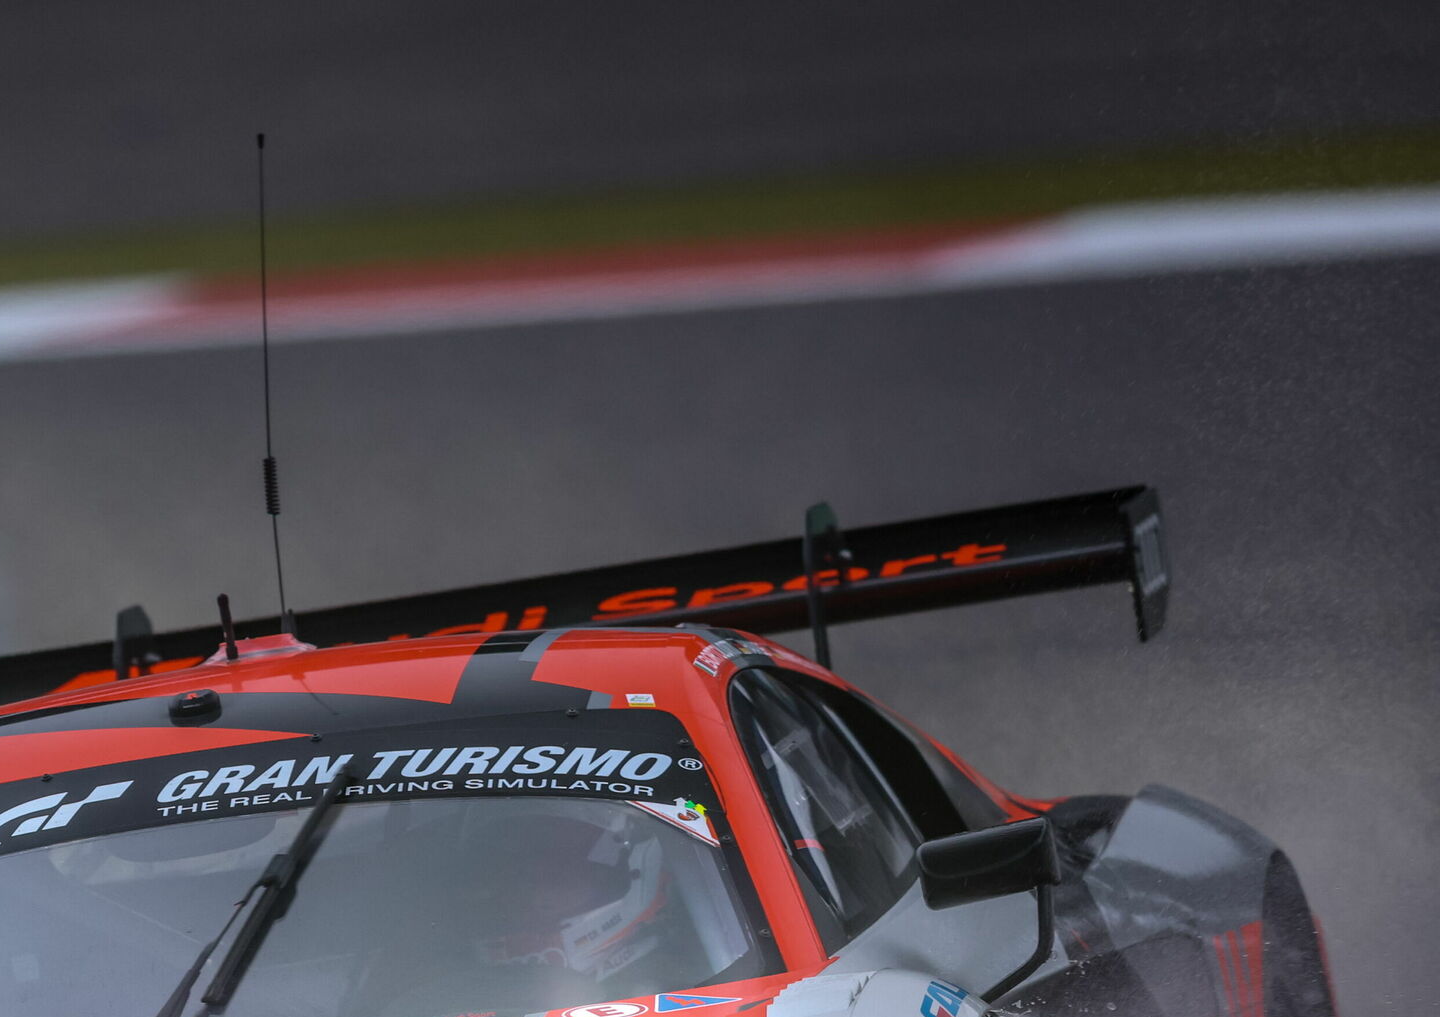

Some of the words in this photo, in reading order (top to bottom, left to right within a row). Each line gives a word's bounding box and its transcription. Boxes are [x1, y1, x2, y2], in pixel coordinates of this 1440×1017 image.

[591, 543, 1008, 620] Sport
[157, 753, 354, 804] GRAN
[157, 800, 219, 817] THE
[230, 790, 312, 808] REAL
[464, 778, 654, 797] SIMULATOR
